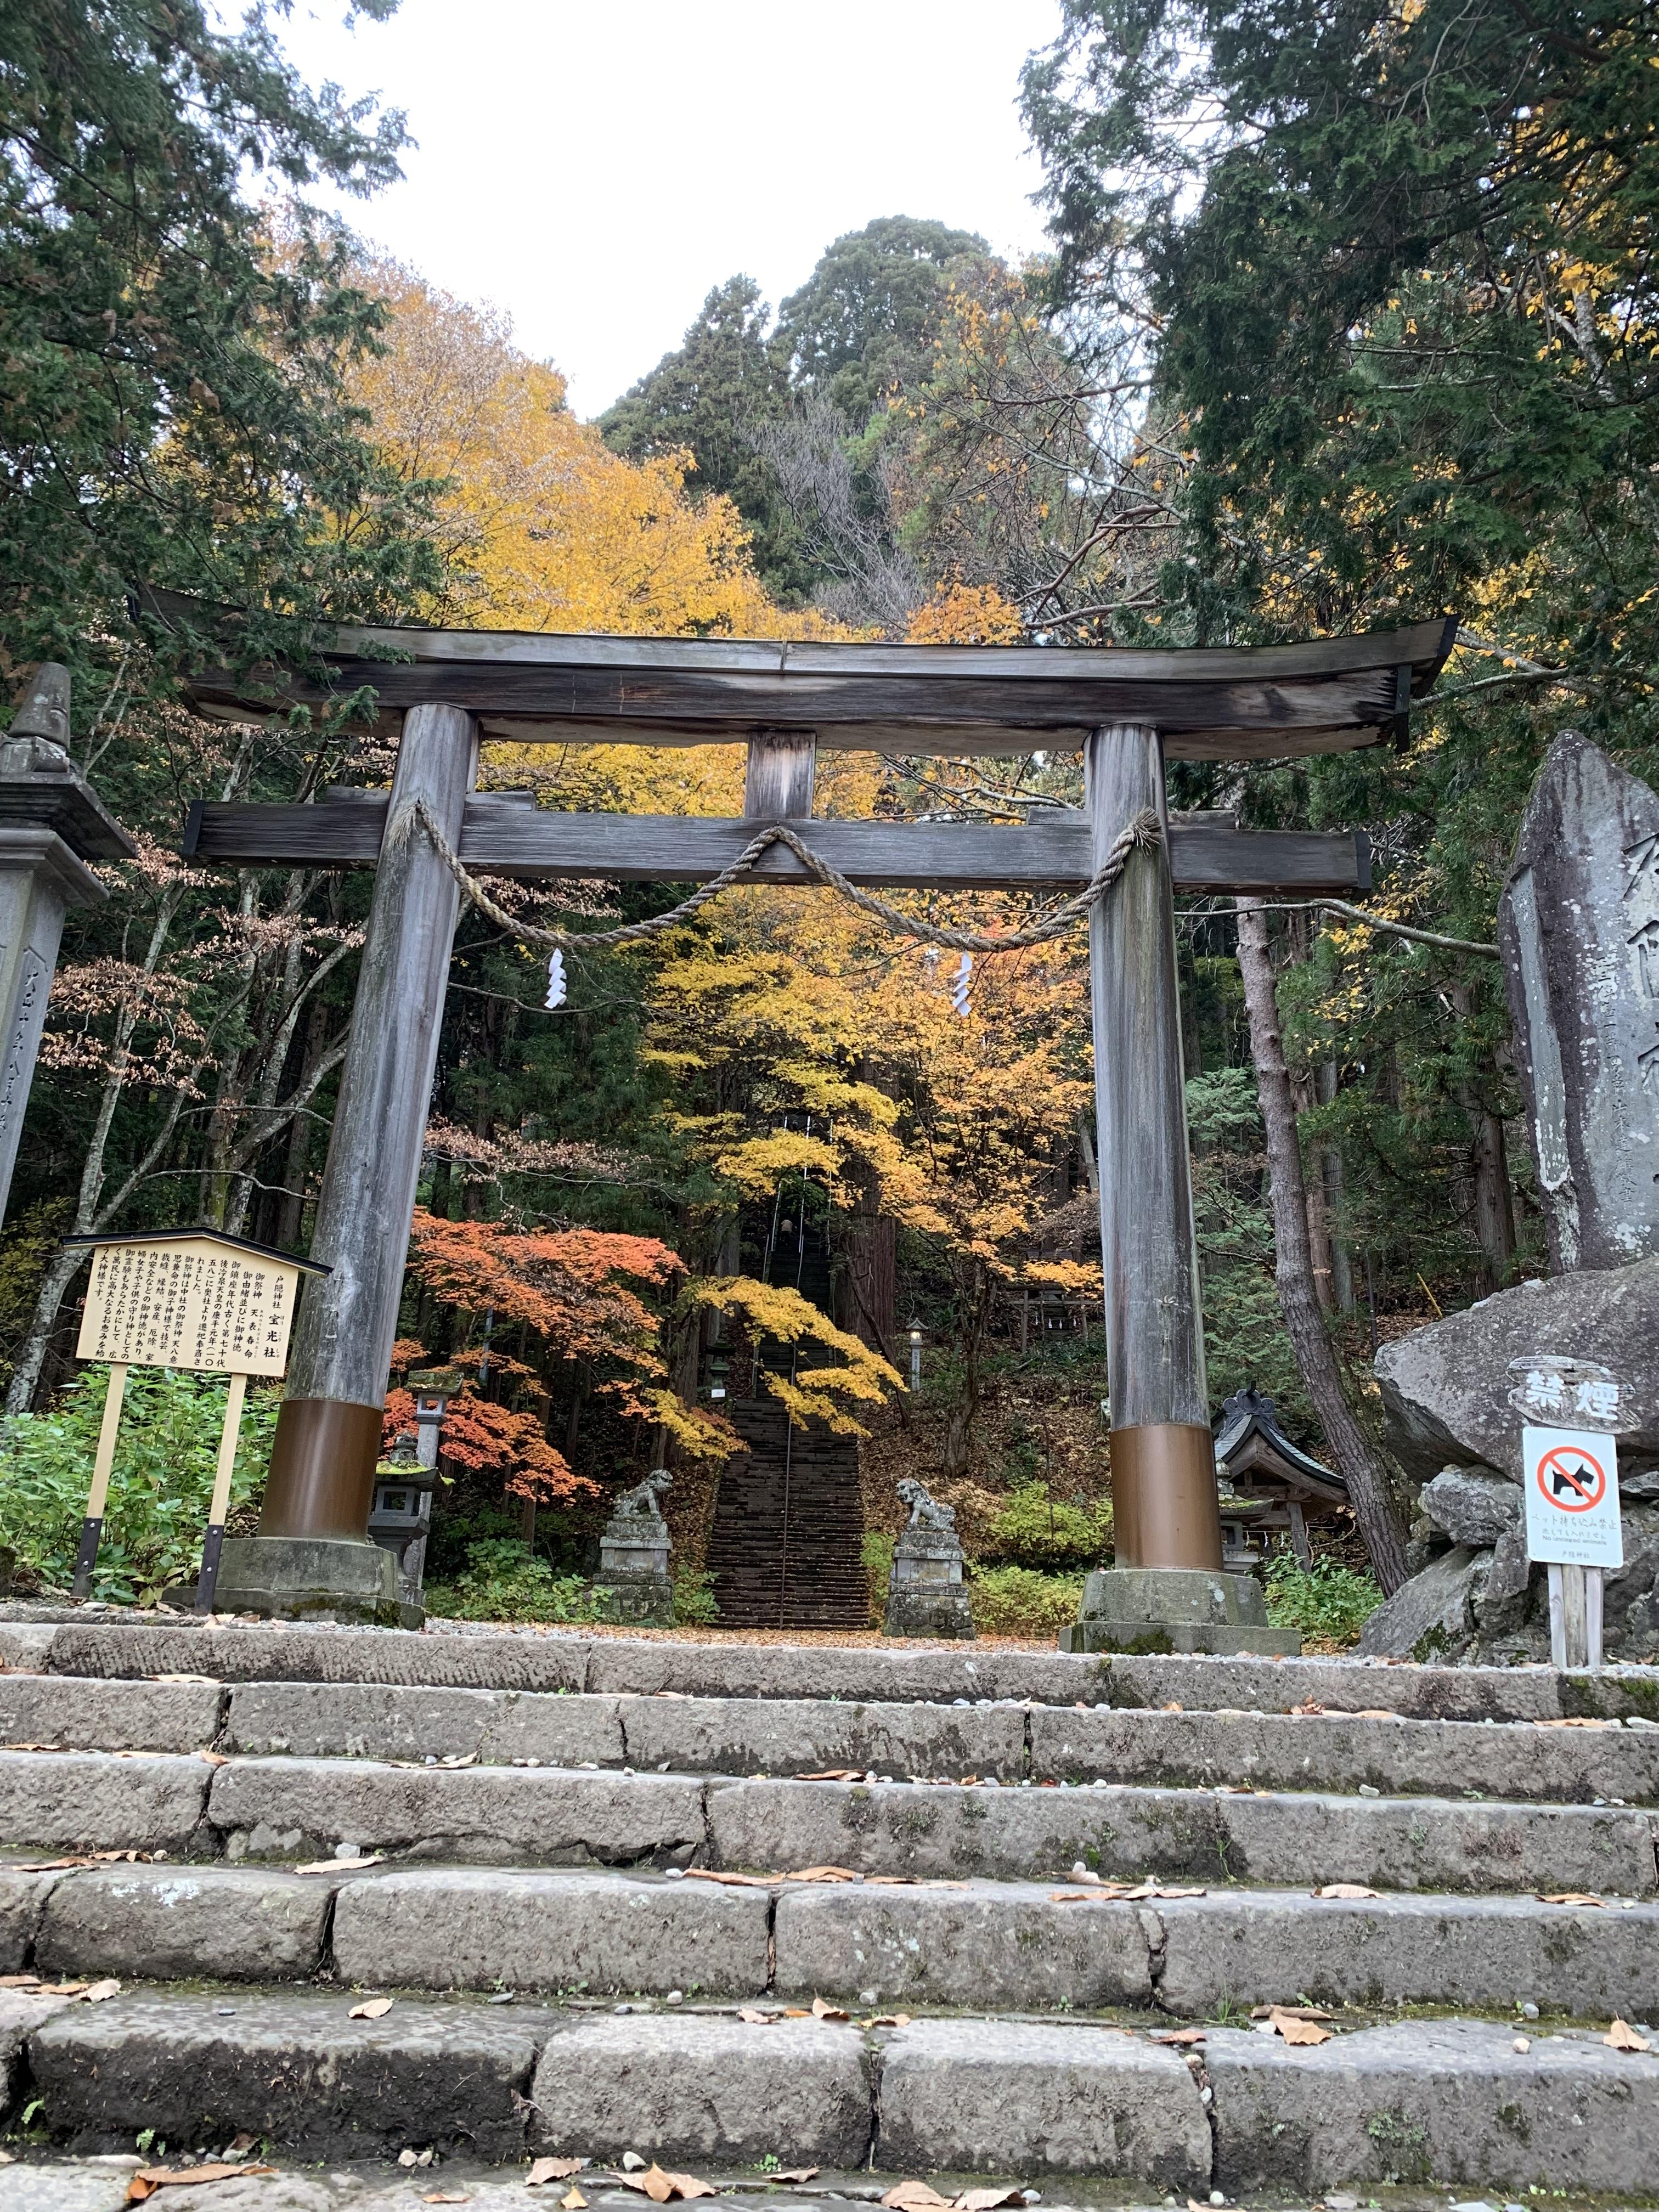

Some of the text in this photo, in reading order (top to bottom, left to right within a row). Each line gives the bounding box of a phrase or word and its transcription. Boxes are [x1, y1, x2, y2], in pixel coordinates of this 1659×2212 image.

[94, 1246, 110, 1301] う大神様です。
[193, 1257, 205, 1295] れました。
[245, 1272, 265, 1358] 御祭神 天表春命
[263, 1275, 284, 1358] 戸隠神社 宝光社
[1526, 1370, 1619, 1420] 禁煙
